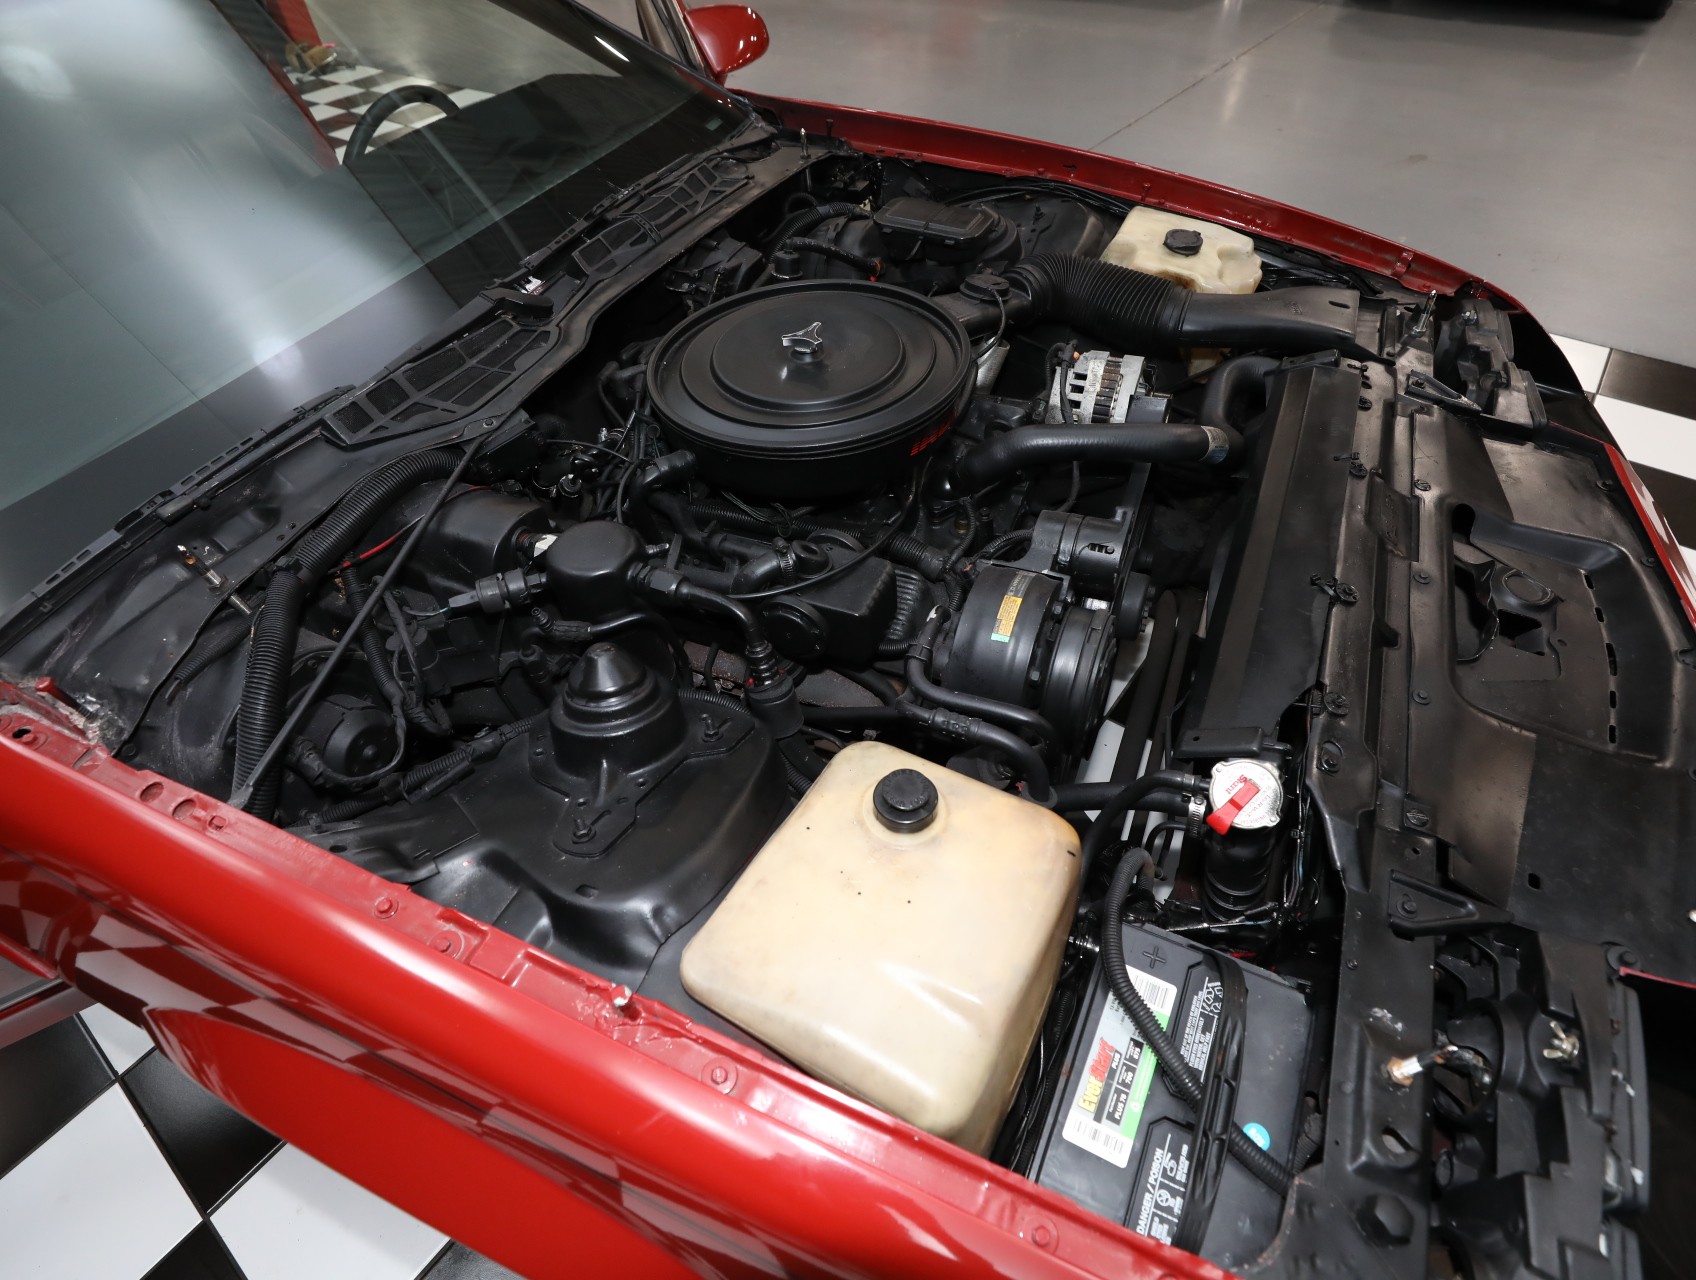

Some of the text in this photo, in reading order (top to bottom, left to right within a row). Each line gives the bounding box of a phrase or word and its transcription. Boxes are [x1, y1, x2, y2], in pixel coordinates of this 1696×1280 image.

[1225, 774, 1248, 795] Stant
[1111, 1052, 1121, 1069] PLUS
[1078, 1039, 1115, 1114] EverStart
[1125, 1071, 1134, 1084] 700
[1114, 1101, 1125, 1120] PLUS
[1120, 1093, 1127, 1102] 78
[1136, 1192, 1153, 1234] DANGER
[1148, 1147, 1164, 1186] POISON
